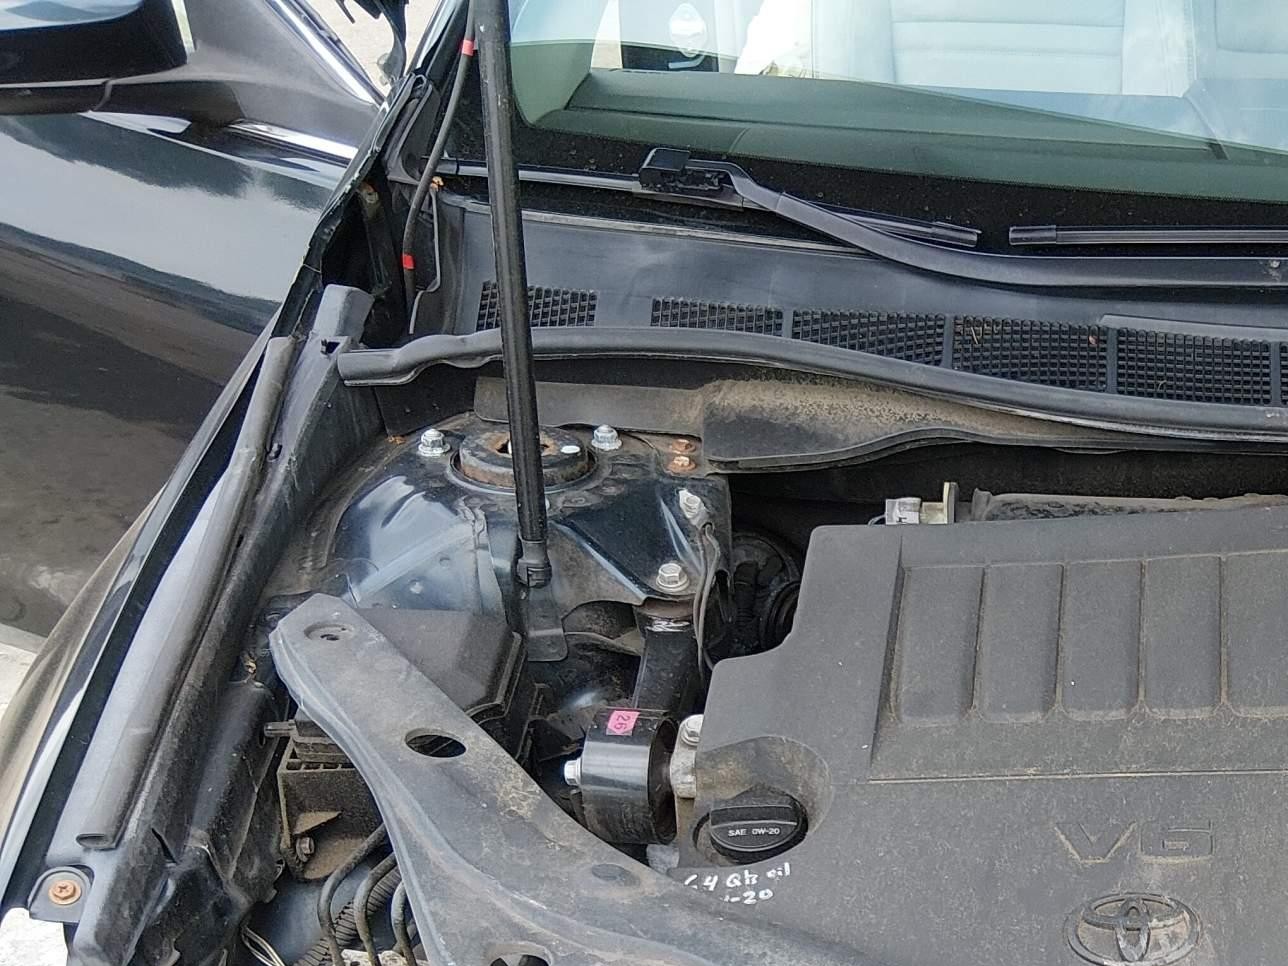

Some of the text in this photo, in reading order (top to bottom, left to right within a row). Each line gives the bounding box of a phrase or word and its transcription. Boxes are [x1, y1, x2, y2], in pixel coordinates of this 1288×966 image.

[727, 827, 781, 837] SAE 0W-20
[1053, 820, 1215, 864] V6
